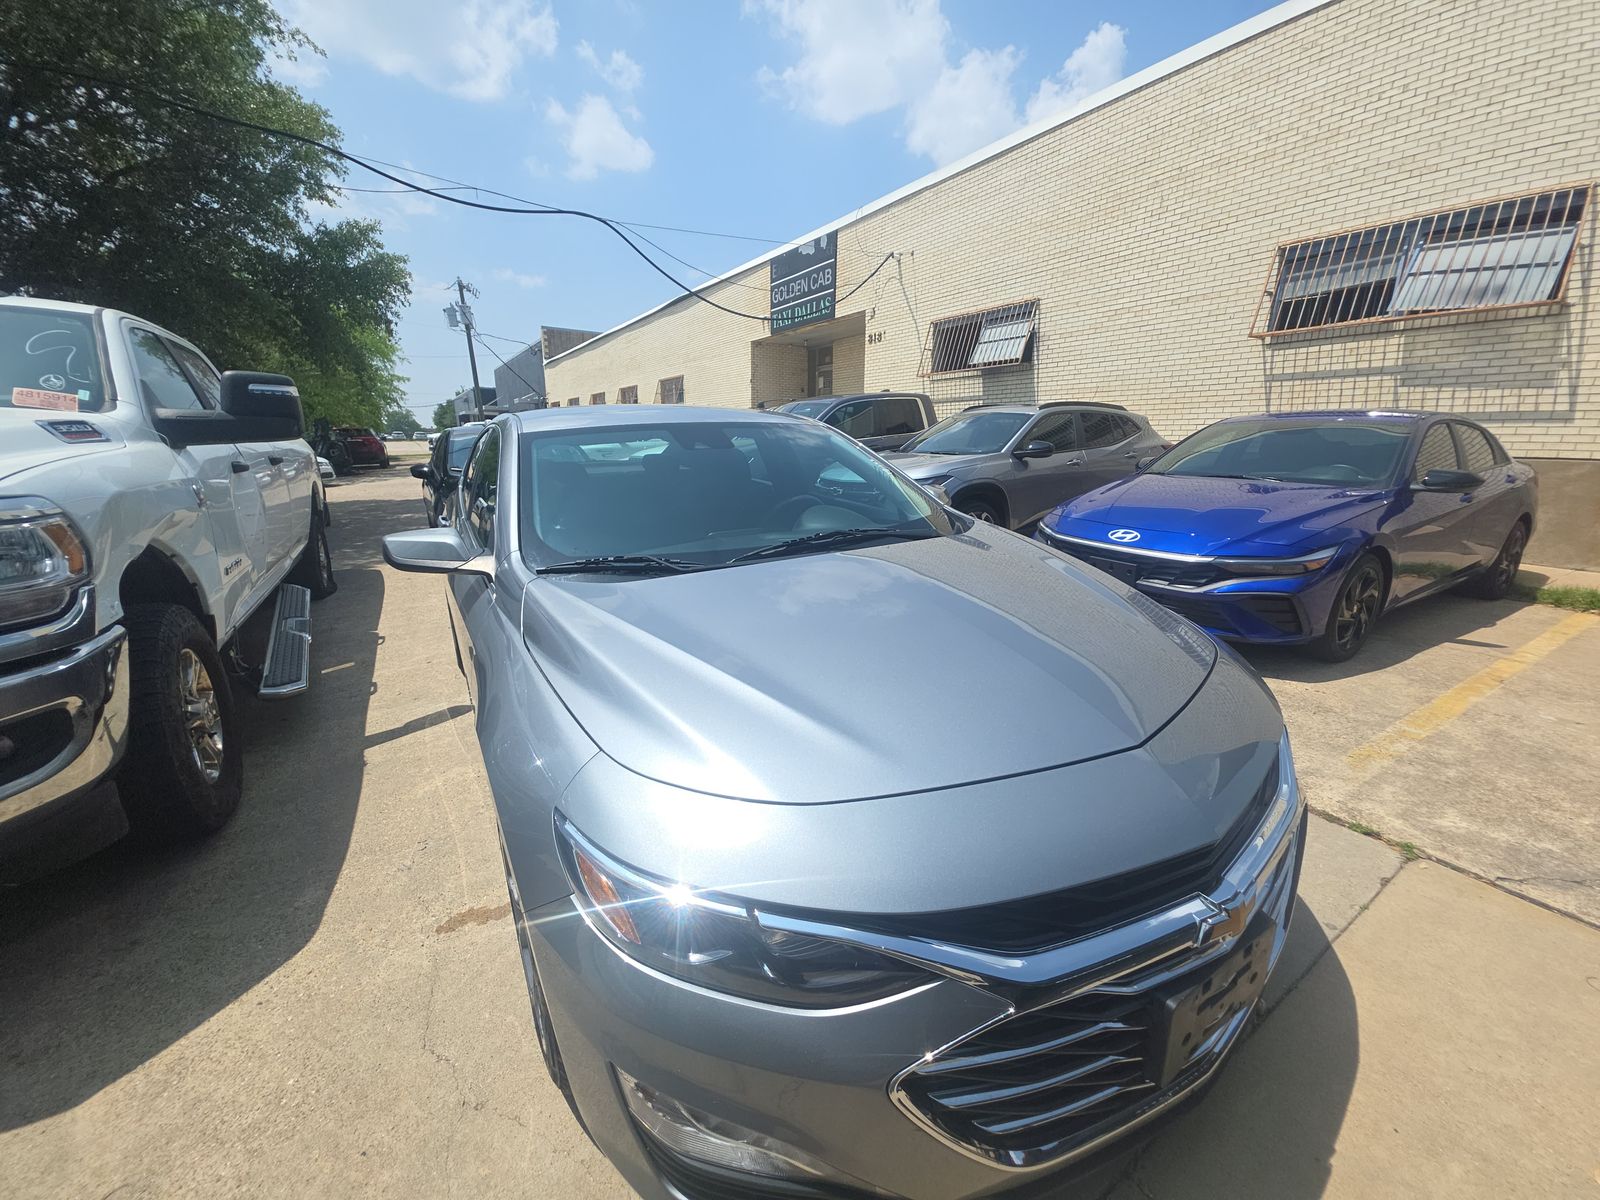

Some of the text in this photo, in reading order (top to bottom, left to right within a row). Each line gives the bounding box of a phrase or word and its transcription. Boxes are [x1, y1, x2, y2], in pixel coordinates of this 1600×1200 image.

[772, 278, 808, 303] GOLDEN
[810, 268, 832, 290] CAB
[772, 297, 832, 329] TAXI DALLAS
